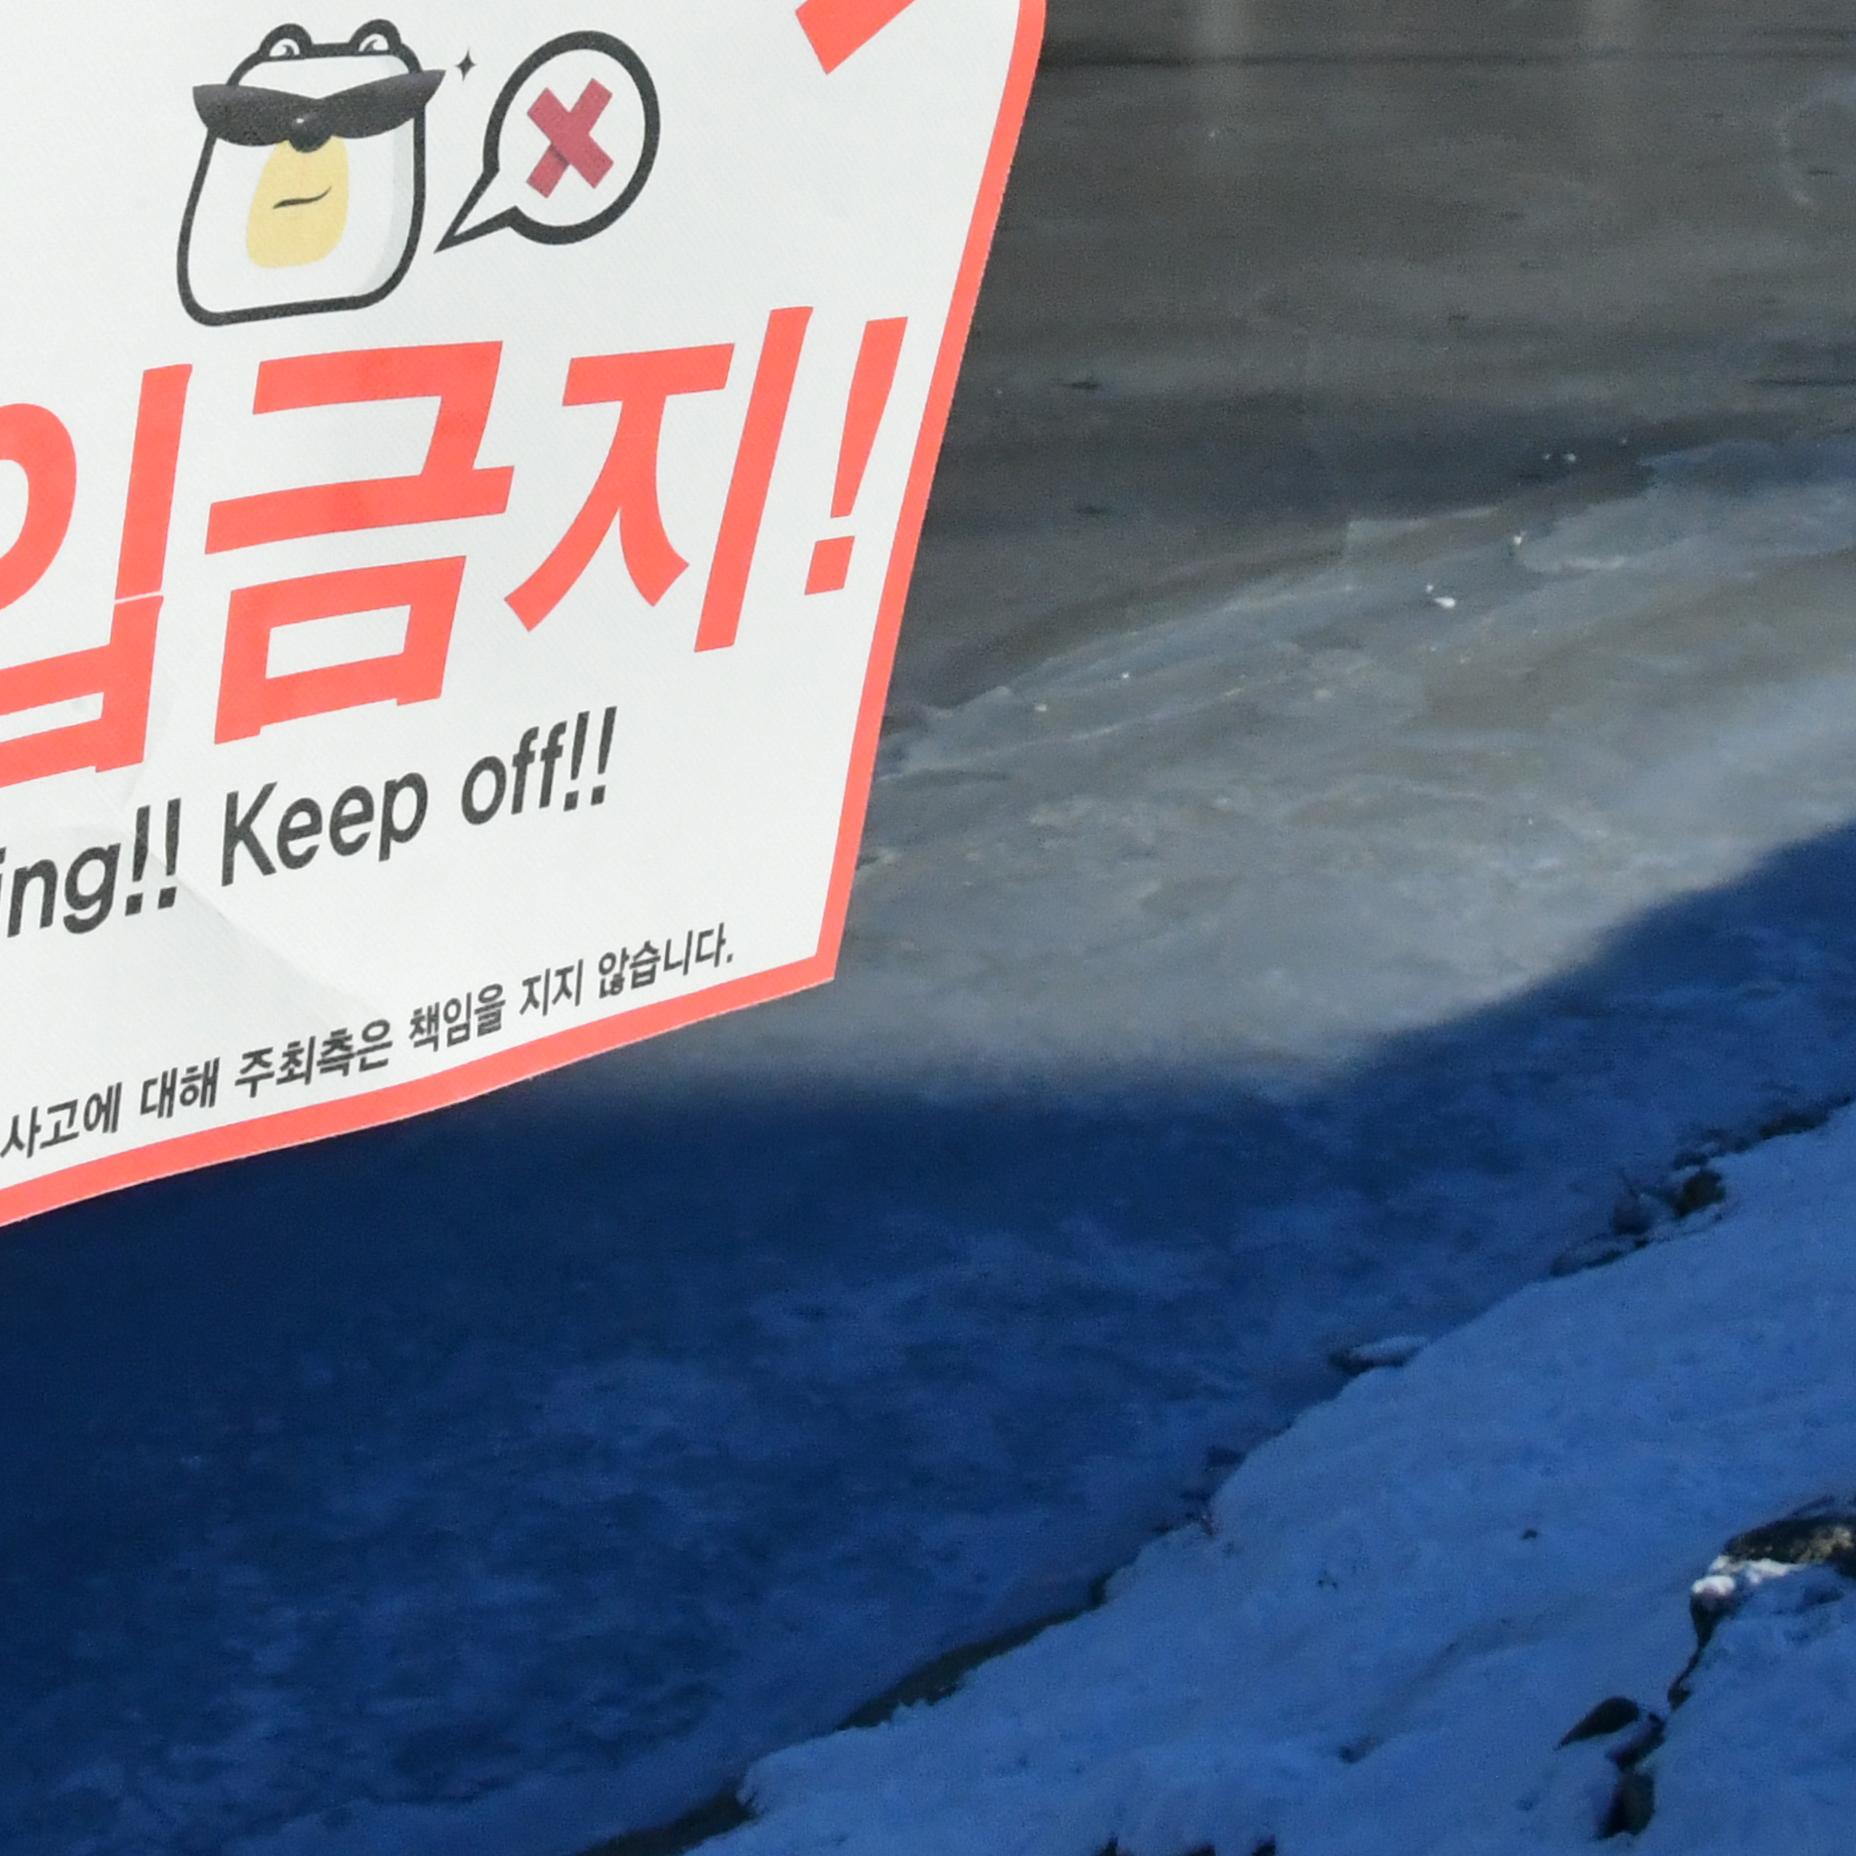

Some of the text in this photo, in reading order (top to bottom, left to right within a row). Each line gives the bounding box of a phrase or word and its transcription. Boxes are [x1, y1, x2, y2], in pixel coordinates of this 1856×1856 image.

[222, 772, 429, 888] Keep
[461, 706, 619, 827] off!!
[139, 1057, 220, 1119] 대해
[234, 1018, 394, 1098] 주최측은
[407, 982, 506, 1053] 책임을
[519, 958, 585, 1016] 지지
[597, 922, 736, 999] 않습니다.
